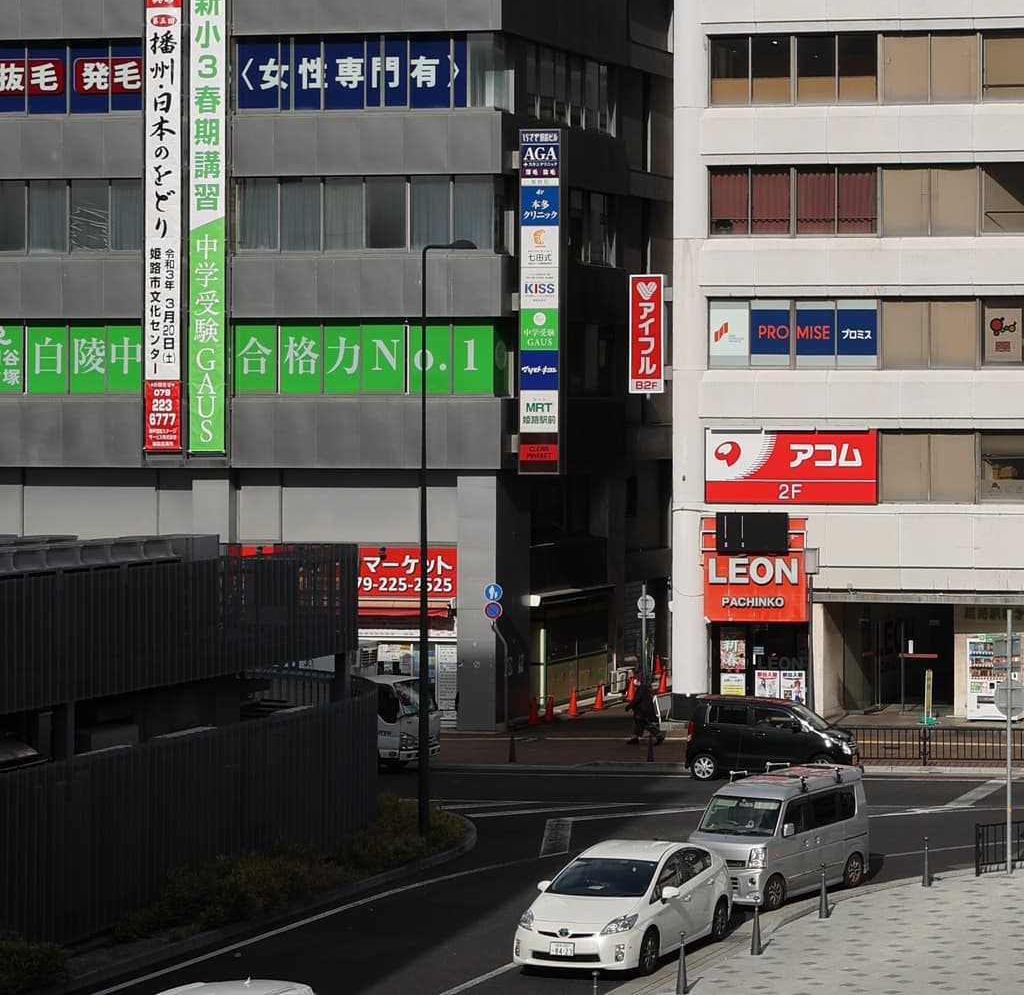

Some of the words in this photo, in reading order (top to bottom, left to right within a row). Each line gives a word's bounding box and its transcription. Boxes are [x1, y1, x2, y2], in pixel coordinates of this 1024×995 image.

[82, 61, 142, 91] 発毛
[523, 147, 558, 160] AGA
[531, 200, 549, 210] 本多
[523, 211, 558, 220] クリニック
[528, 254, 553, 262] 七田式
[525, 283, 555, 294] KISS
[149, 247, 161, 375] 姫路市文化センター
[638, 302, 657, 375] アイフル
[758, 325, 831, 340] PROMISE
[842, 328, 872, 340] プロミス
[527, 338, 553, 347] GAUS
[34, 337, 141, 375] 白陵中
[635, 381, 657, 390] B2F
[152, 399, 172, 412] 223
[526, 402, 553, 413] MRT
[149, 413, 176, 426] 6777
[789, 443, 863, 468] アコム
[778, 484, 803, 499] 2F
[363, 555, 453, 575] マーケット
[721, 597, 785, 608] PACHINKO
